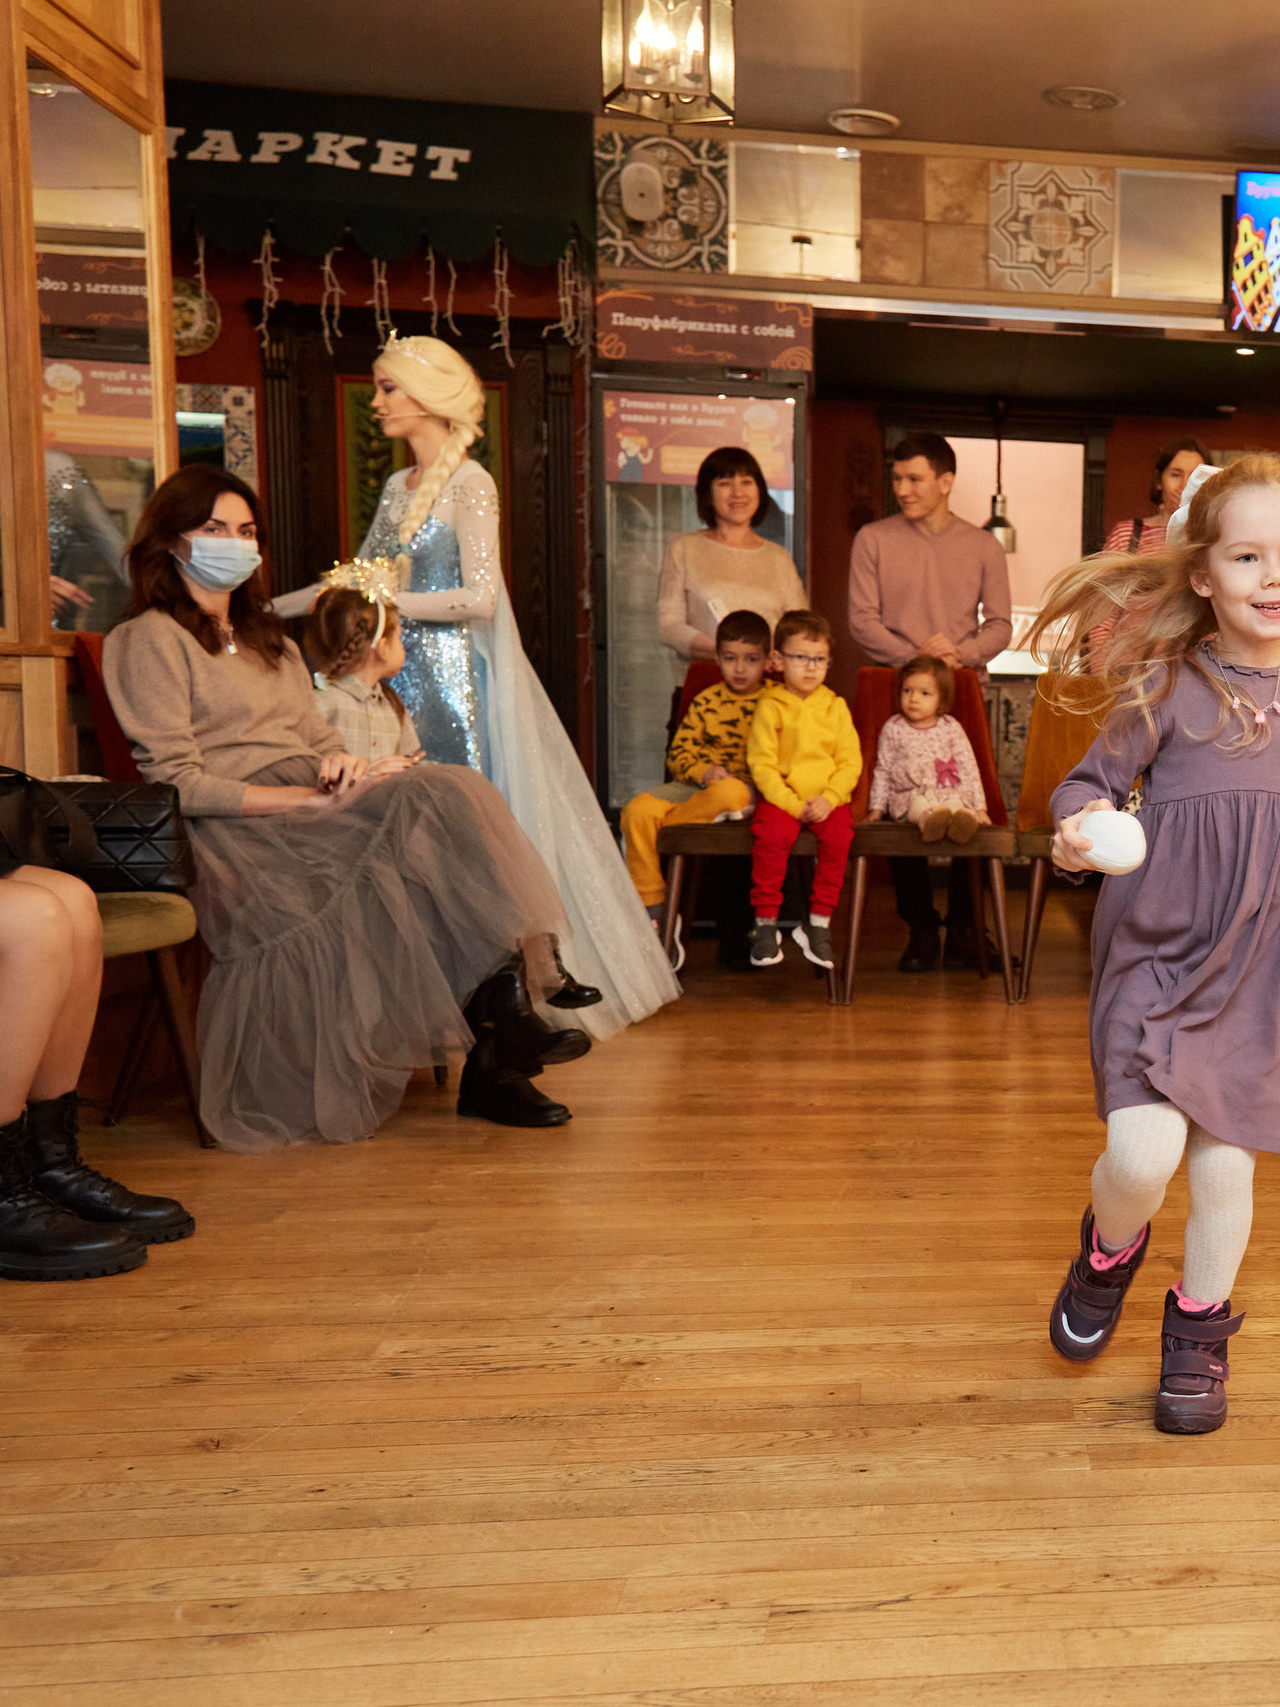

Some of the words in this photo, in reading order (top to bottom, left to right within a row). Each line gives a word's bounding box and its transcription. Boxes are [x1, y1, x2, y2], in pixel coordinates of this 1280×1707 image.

[611, 312, 737, 333] Полуфабрикаты
[740, 323, 749, 335] с
[753, 323, 796, 338] собой
